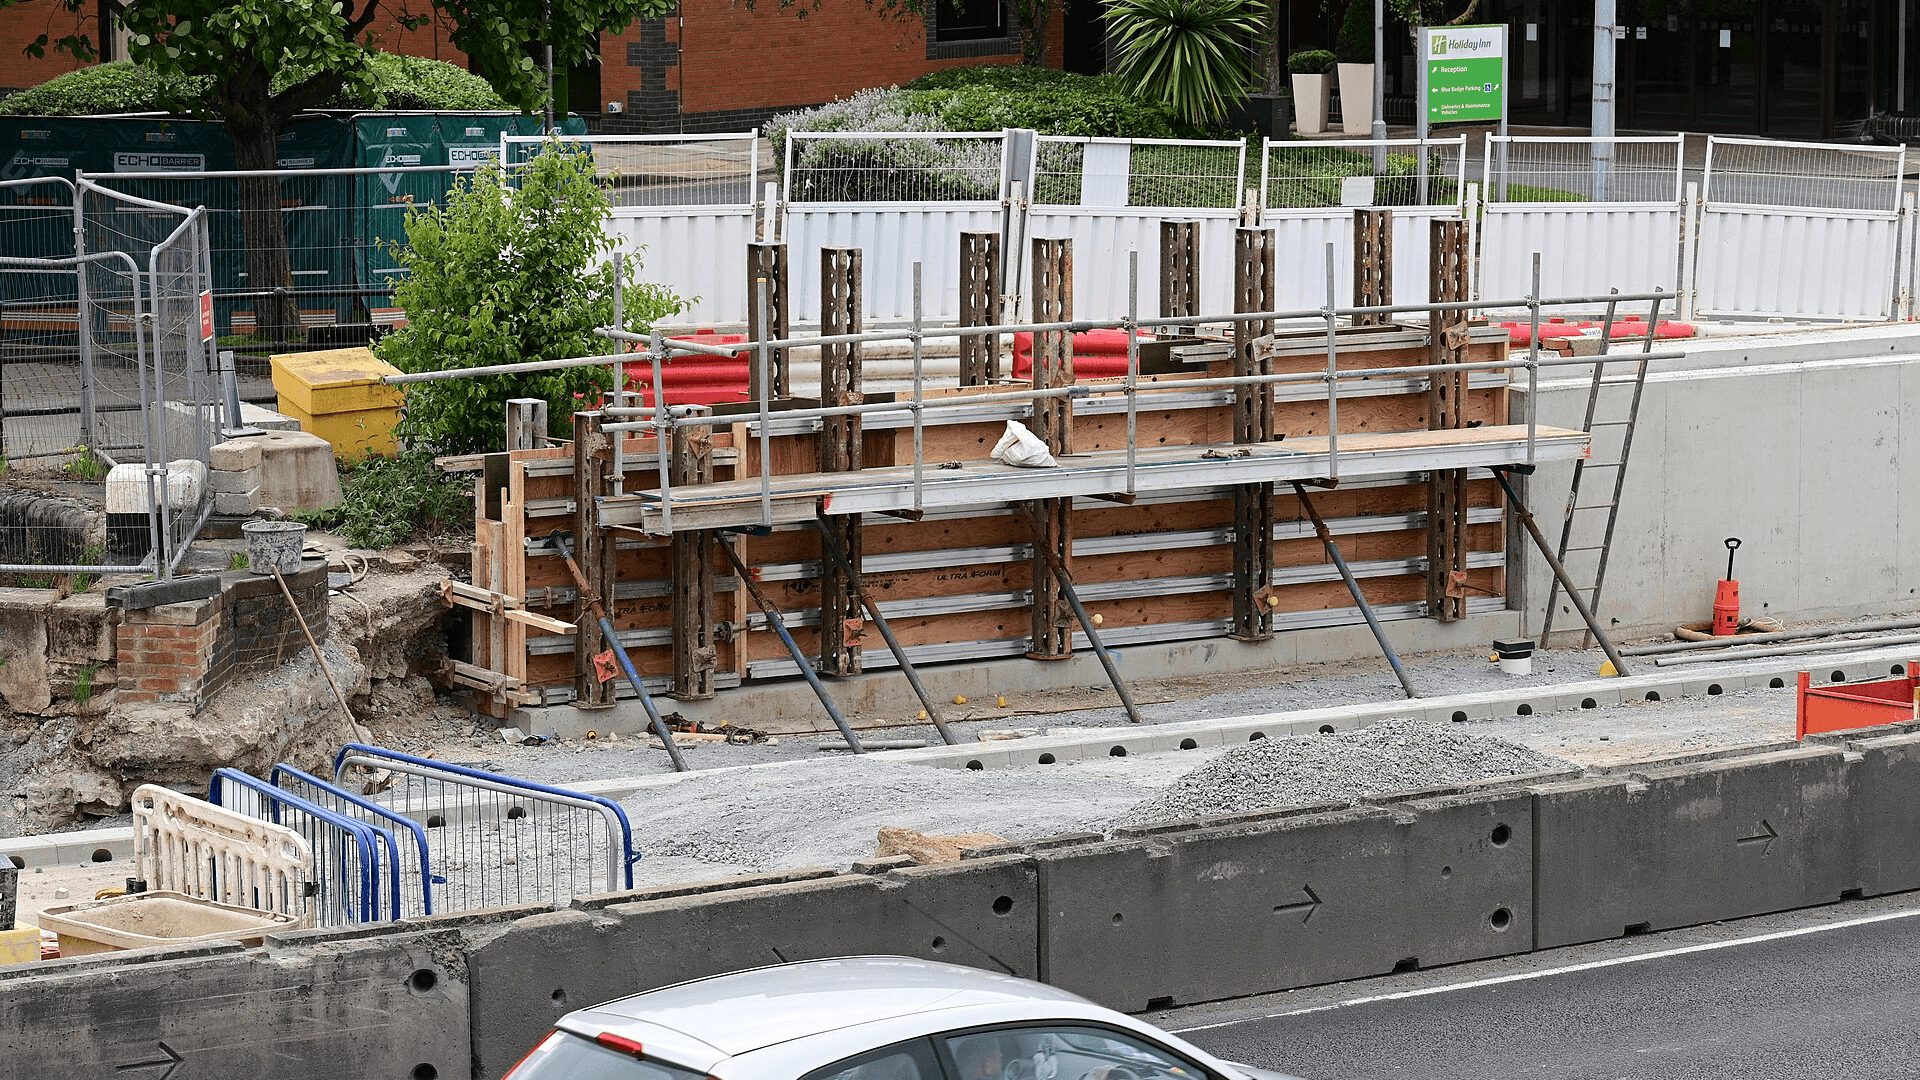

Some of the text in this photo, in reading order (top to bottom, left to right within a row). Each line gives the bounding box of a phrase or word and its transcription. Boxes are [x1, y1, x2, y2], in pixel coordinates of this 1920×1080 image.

[1448, 39, 1491, 50] Holiday Inn
[118, 155, 200, 166] ECHO BARRIER
[451, 150, 478, 161] ECHO
